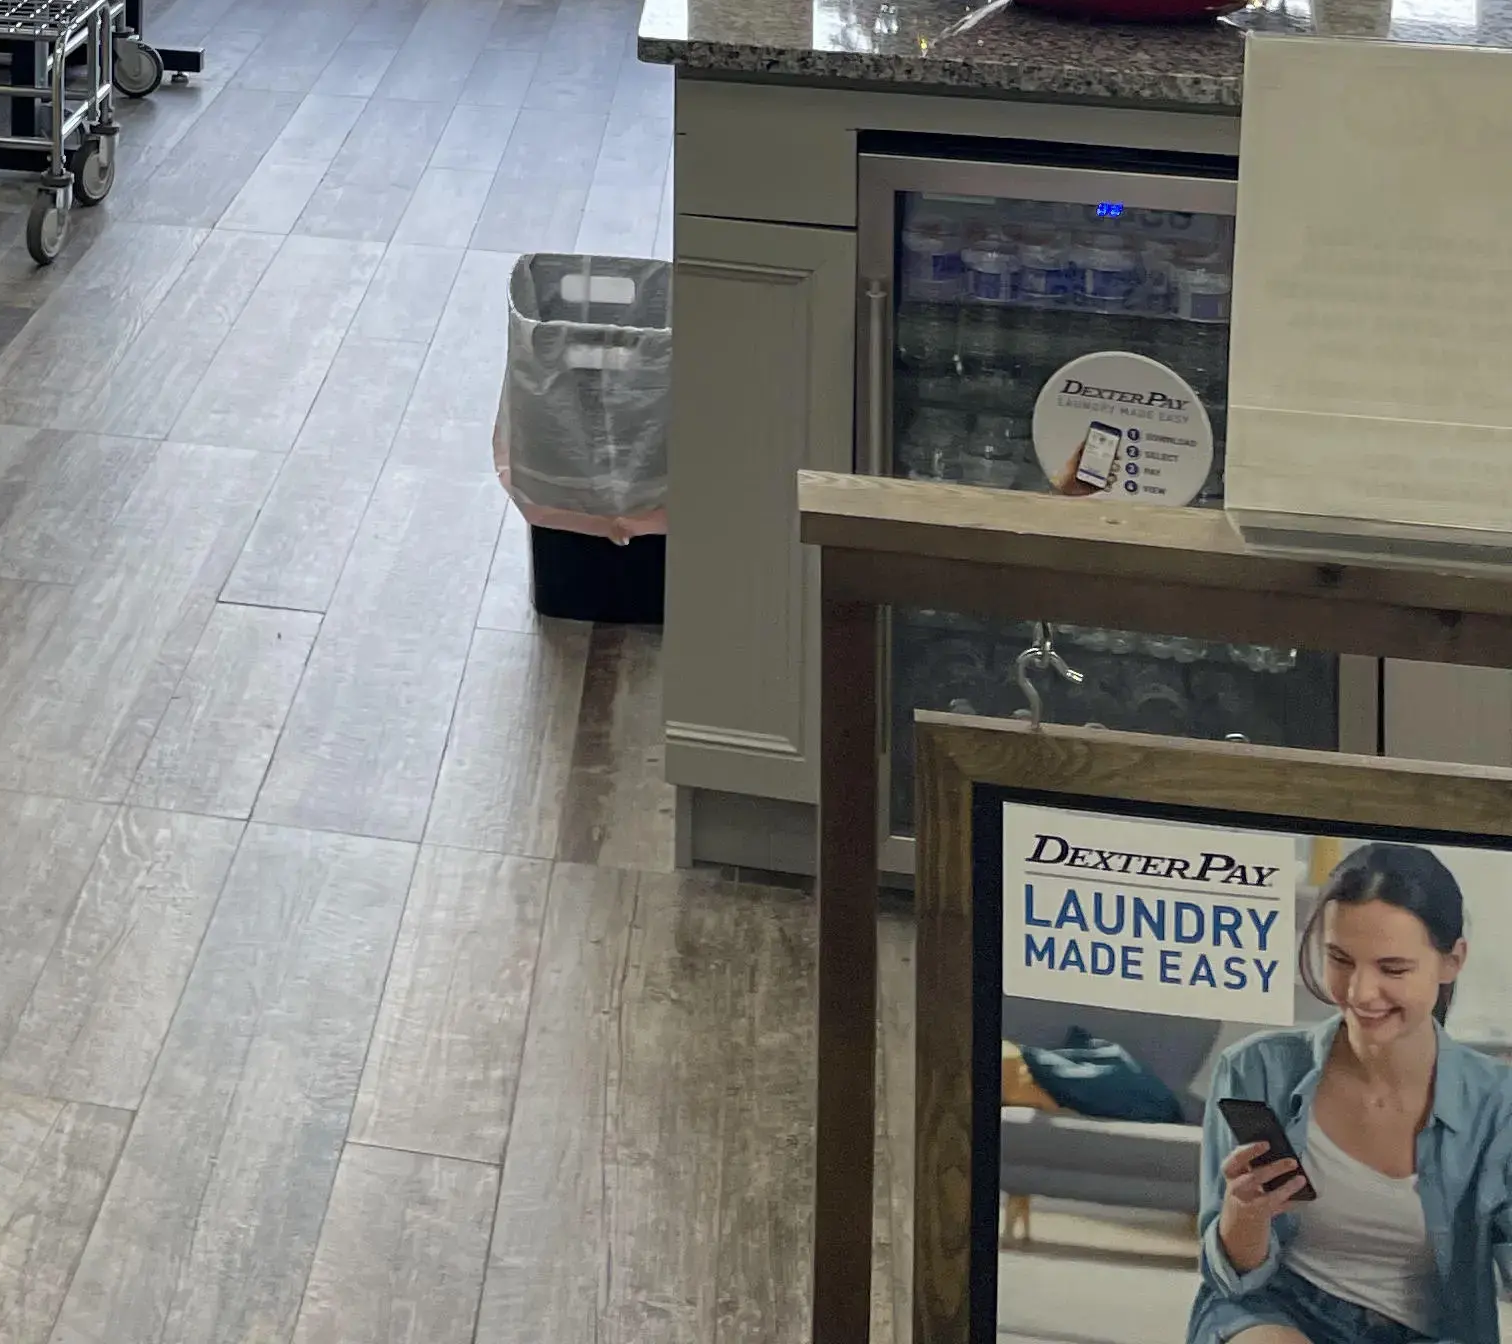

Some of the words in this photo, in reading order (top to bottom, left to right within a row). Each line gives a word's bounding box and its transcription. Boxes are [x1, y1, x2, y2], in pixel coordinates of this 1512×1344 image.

[1025, 884, 1279, 951] LAUNDRY
[1025, 934, 1144, 981] MADE
[1160, 950, 1279, 993] EASY
